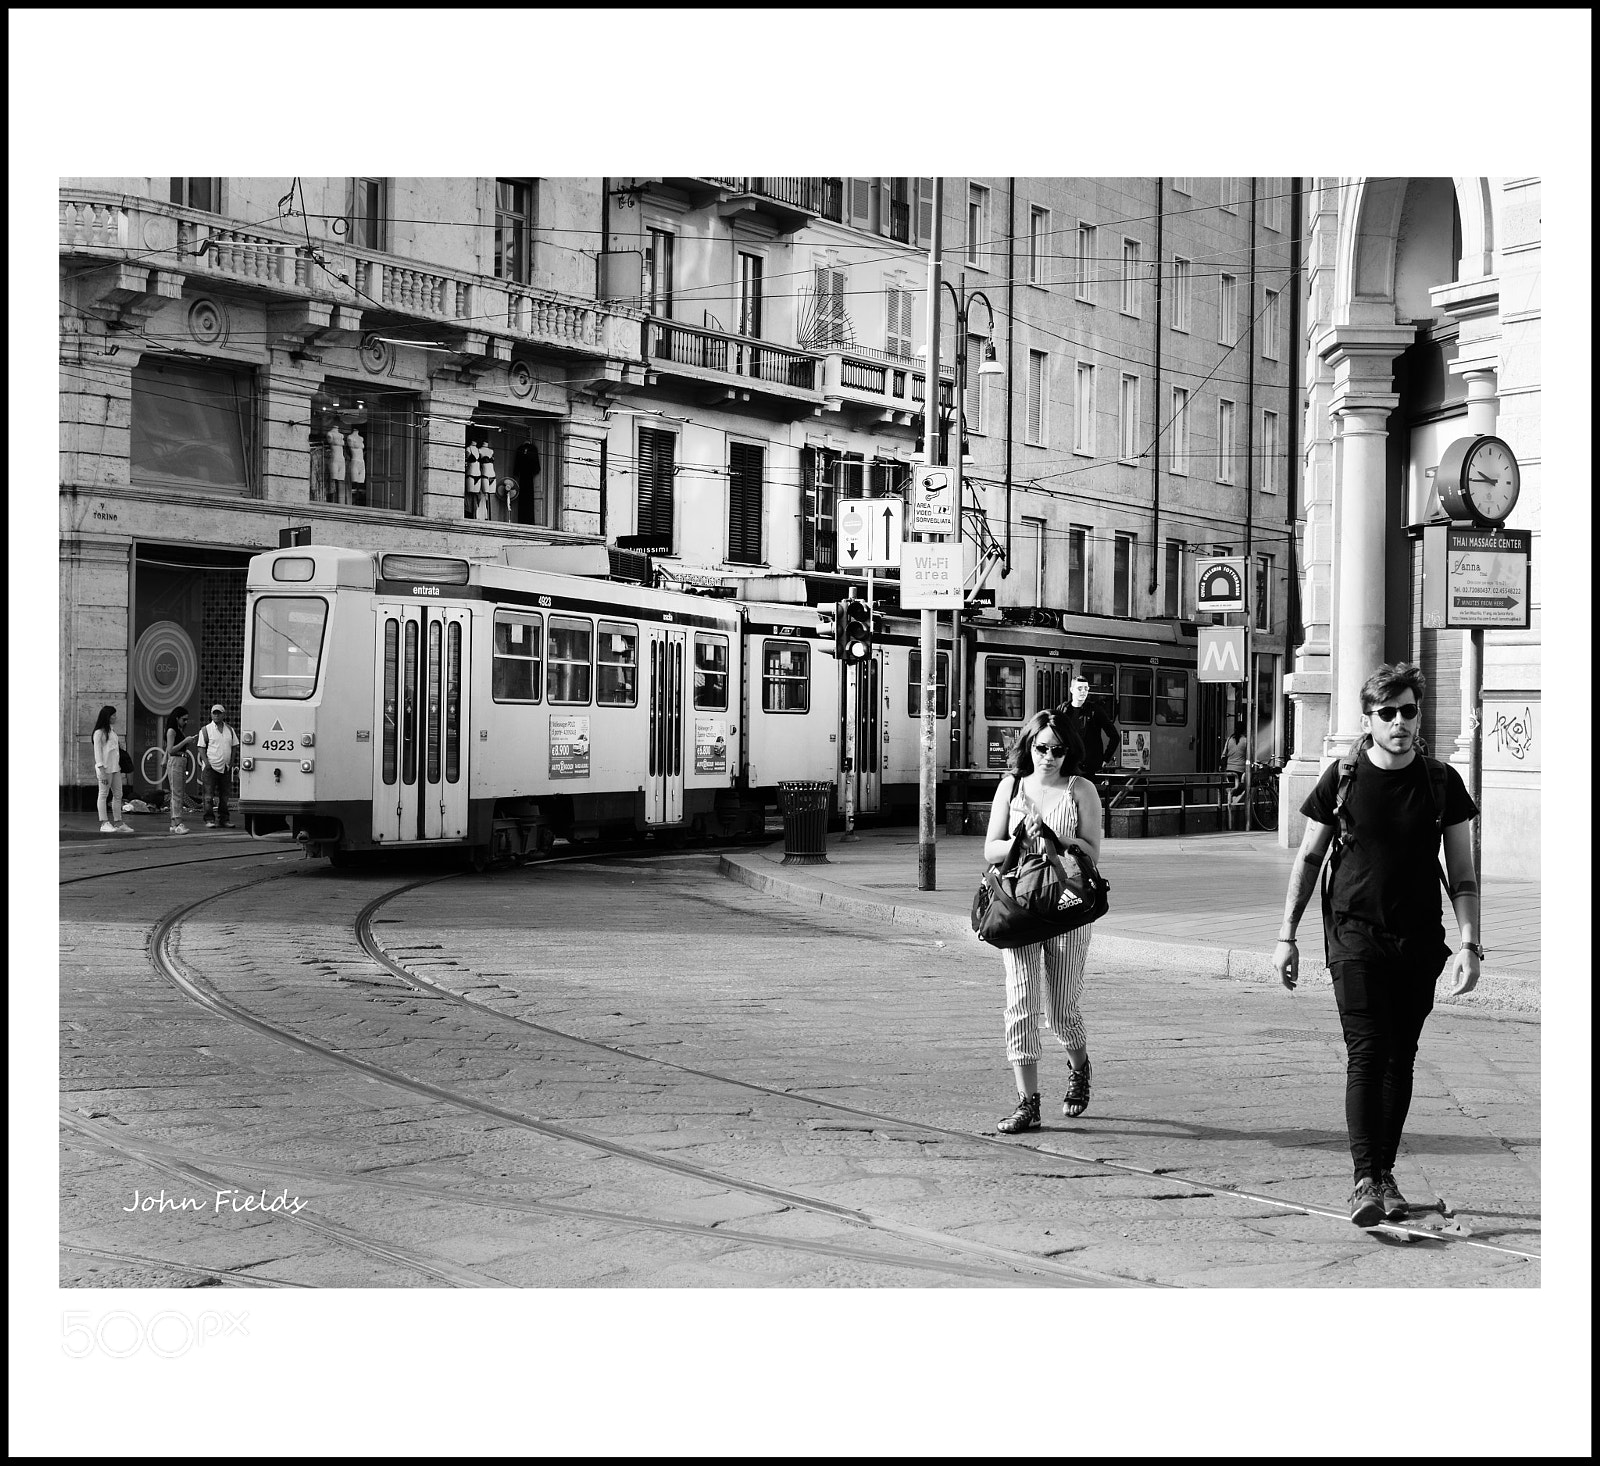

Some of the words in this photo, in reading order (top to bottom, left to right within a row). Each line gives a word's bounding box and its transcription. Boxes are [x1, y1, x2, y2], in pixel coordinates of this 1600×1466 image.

[93, 511, 118, 521] TORINO
[915, 516, 952, 525] SORVEGLIATA
[1452, 536, 1468, 547] THAI
[1469, 537, 1497, 548] MASSAGE
[1498, 538, 1522, 549] CENTER
[914, 556, 949, 569] Wi-Fi
[914, 571, 949, 580] area
[412, 586, 440, 596] entrata
[538, 596, 552, 607] 4923
[1456, 598, 1461, 606] 7
[1202, 641, 1240, 671] M
[262, 739, 295, 752] 4923
[1057, 897, 1084, 911] adidas
